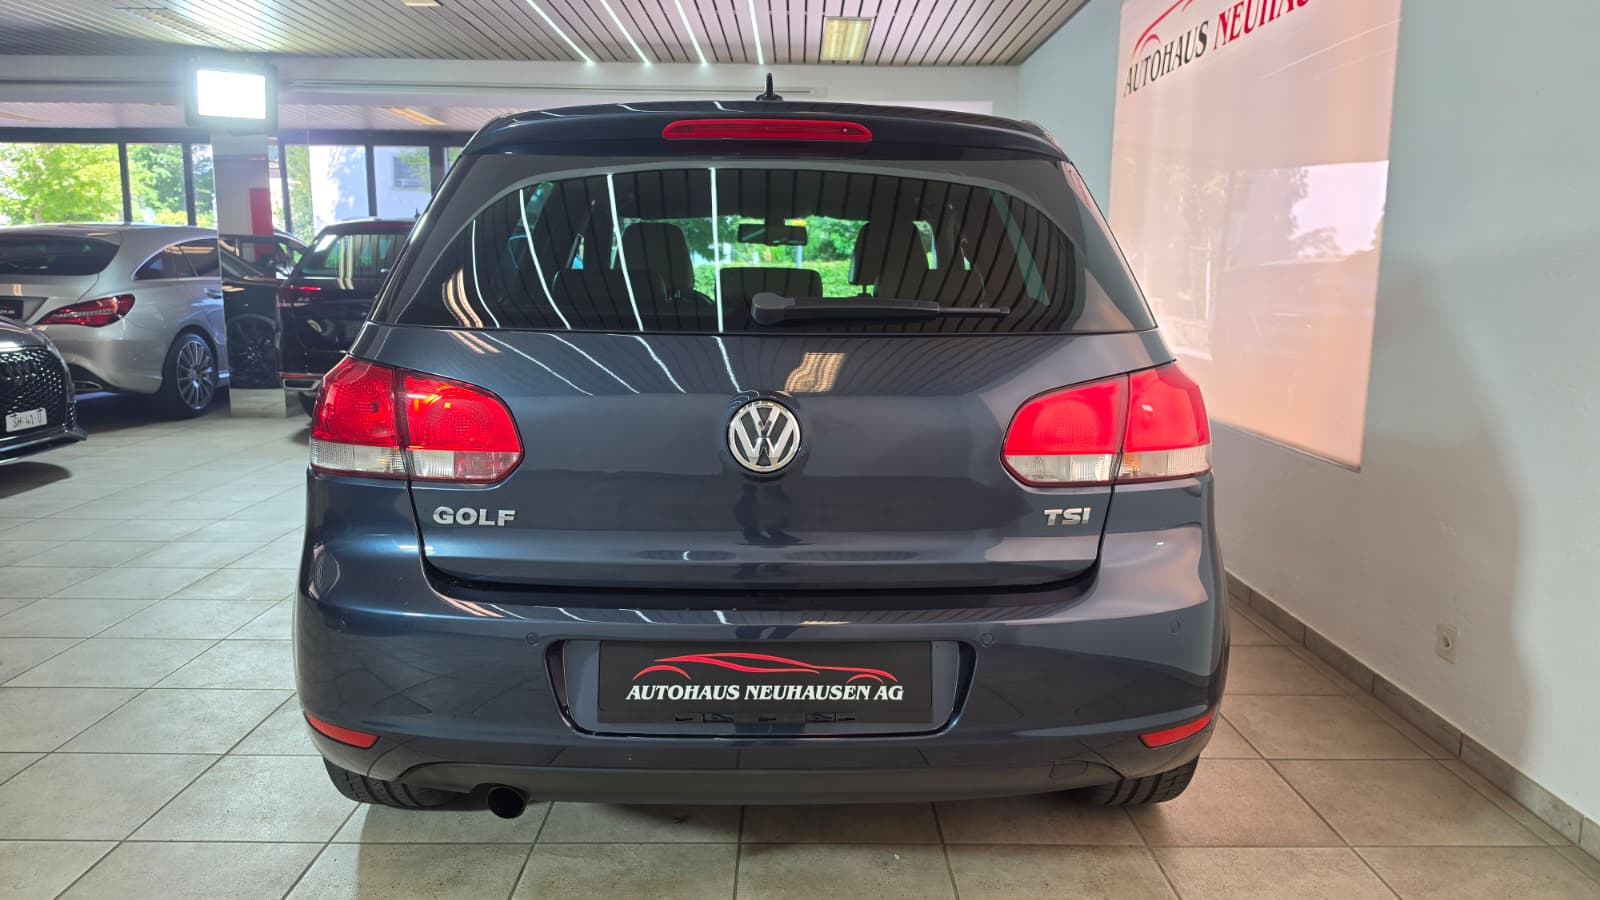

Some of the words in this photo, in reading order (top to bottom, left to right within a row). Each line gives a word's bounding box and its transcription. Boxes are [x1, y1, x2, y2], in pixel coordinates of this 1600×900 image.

[1123, 20, 1209, 98] AUTOHAUS
[433, 506, 516, 526] GOLF
[1043, 507, 1091, 526] TSI
[626, 685, 740, 700] AUTOHAUS
[744, 685, 871, 700] NEUHAUSEN
[874, 685, 904, 700] AG
